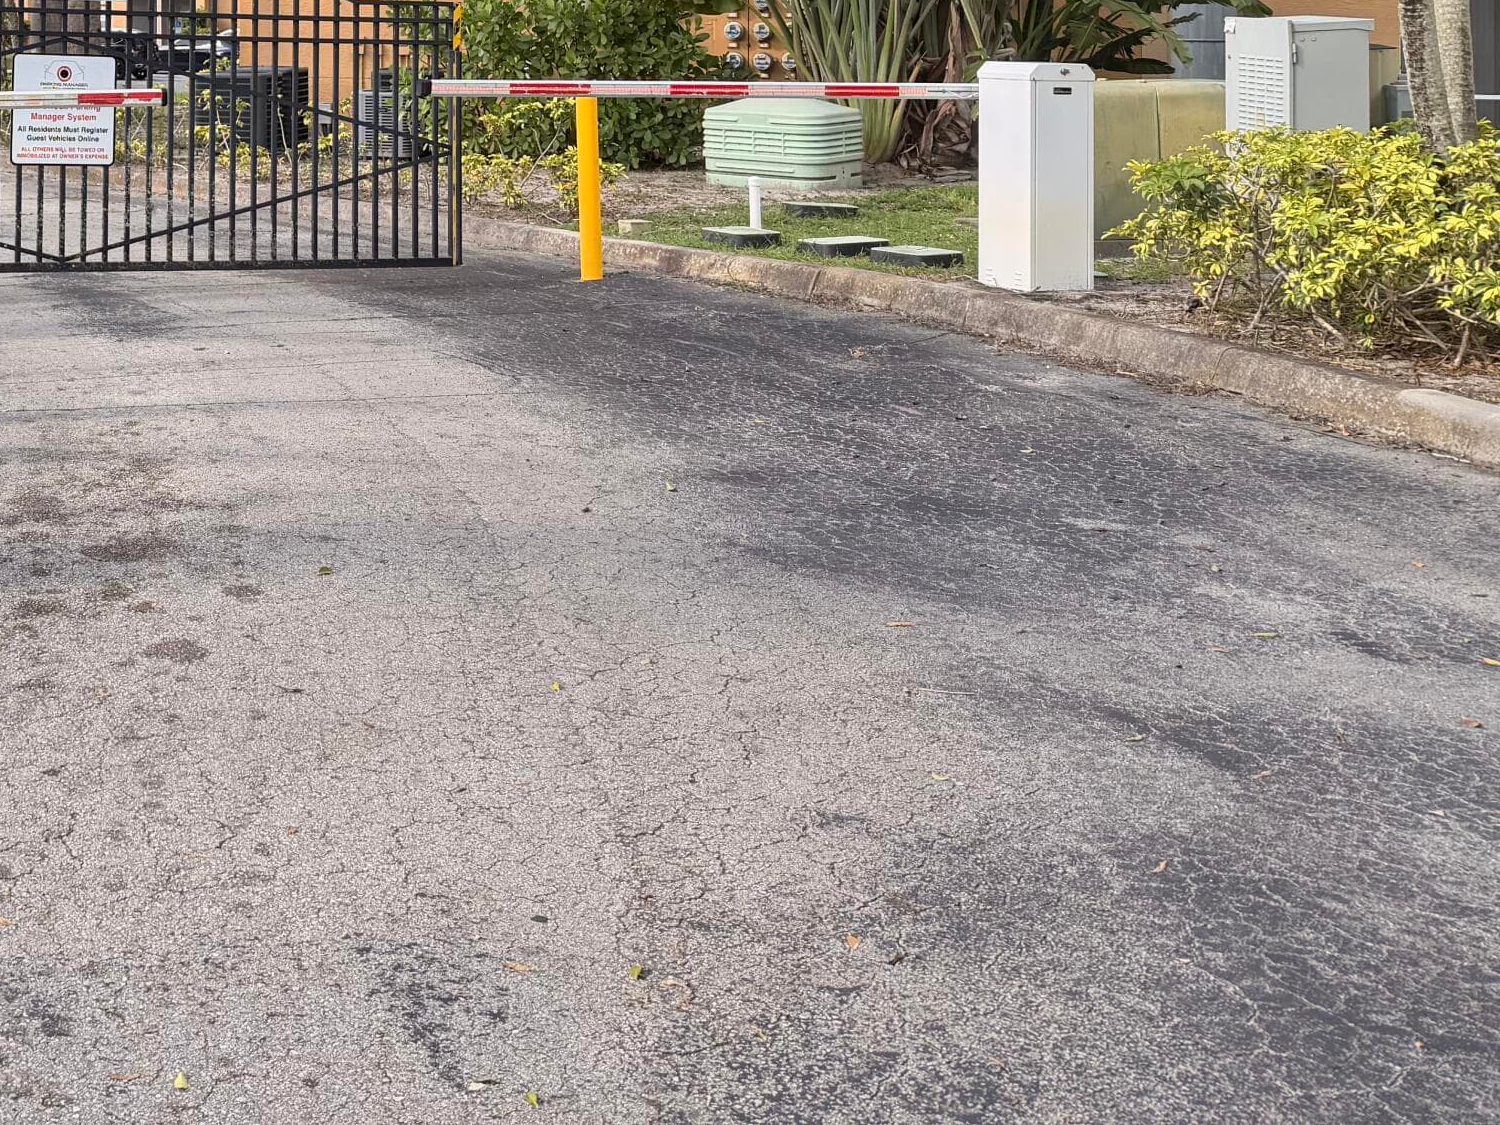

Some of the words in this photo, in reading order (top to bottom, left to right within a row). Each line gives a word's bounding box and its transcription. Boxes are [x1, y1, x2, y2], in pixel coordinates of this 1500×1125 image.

[31, 112, 65, 122] Manager
[67, 113, 97, 123] System
[28, 125, 61, 133] Residents
[81, 126, 108, 134] Register
[26, 134, 47, 142] Guest
[49, 134, 76, 142] Vehicles
